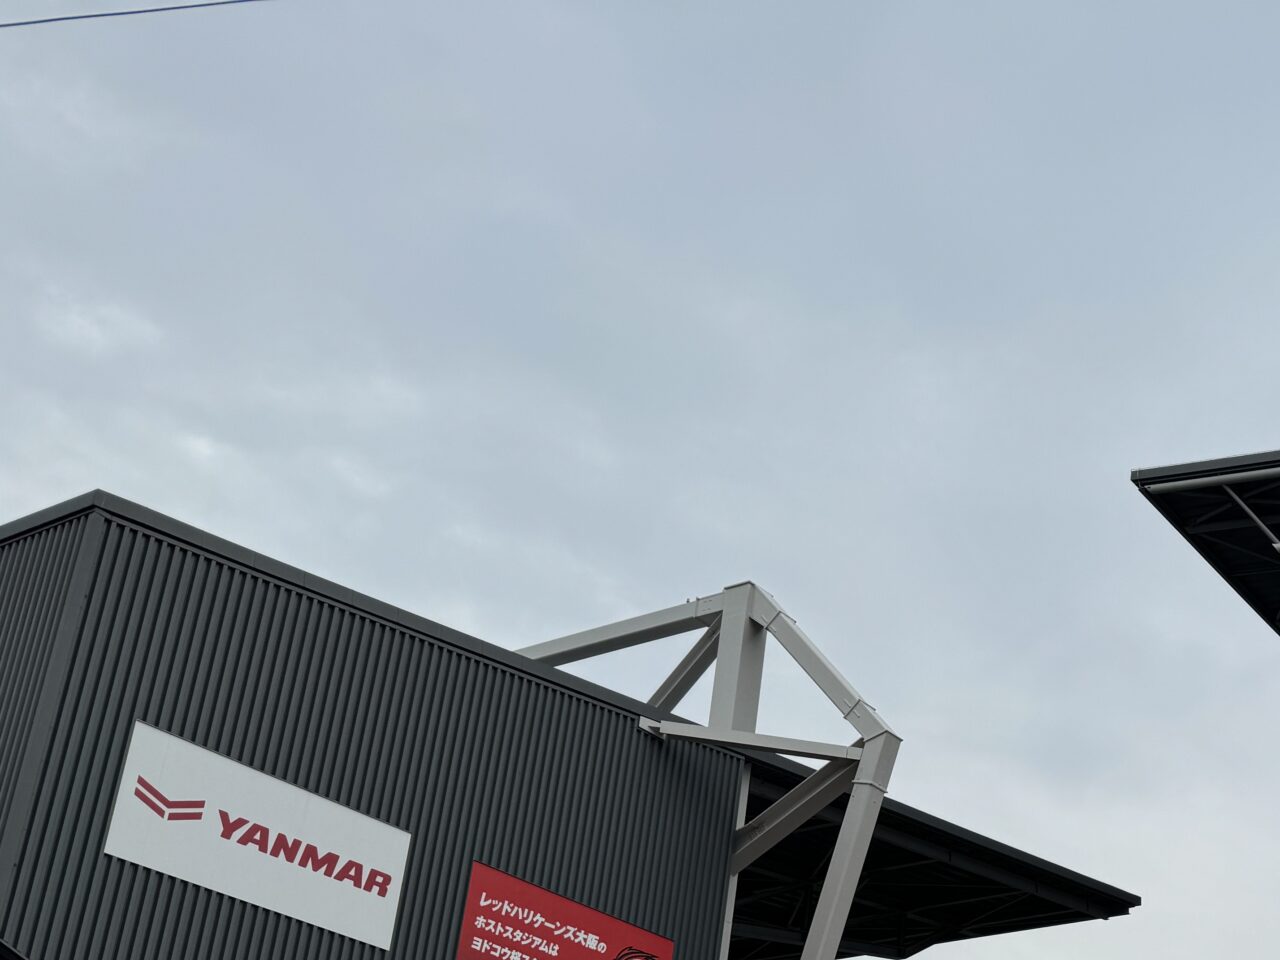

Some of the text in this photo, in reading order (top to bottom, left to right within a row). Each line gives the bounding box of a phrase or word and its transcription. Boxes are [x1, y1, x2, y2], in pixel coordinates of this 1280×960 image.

[218, 809, 392, 898] YANMAR
[475, 916, 560, 957] ホストスタジアムは
[480, 892, 607, 953] レッドハリケーンズ大阪の
